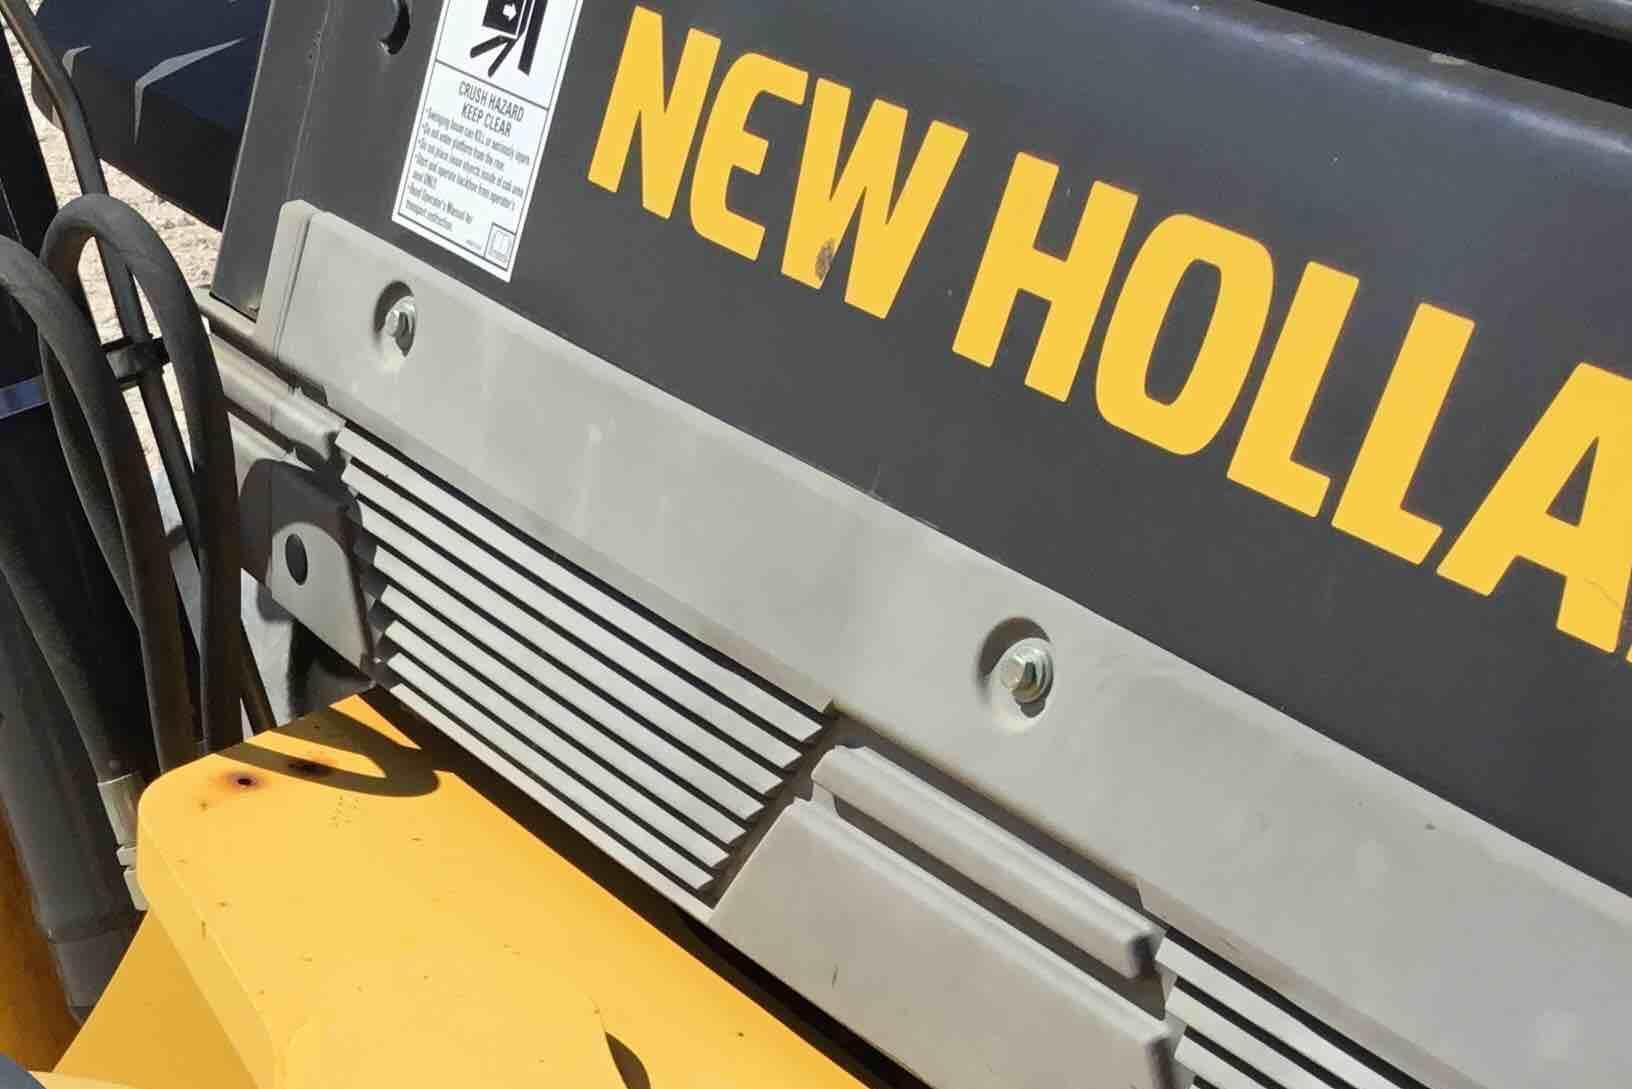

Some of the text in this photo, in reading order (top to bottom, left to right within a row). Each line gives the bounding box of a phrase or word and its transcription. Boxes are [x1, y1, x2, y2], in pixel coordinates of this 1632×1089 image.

[458, 82, 526, 122] CRUSH HAZARD
[462, 103, 513, 137] KEEP CLEAR
[587, 5, 1632, 665] NEW HOLLA
